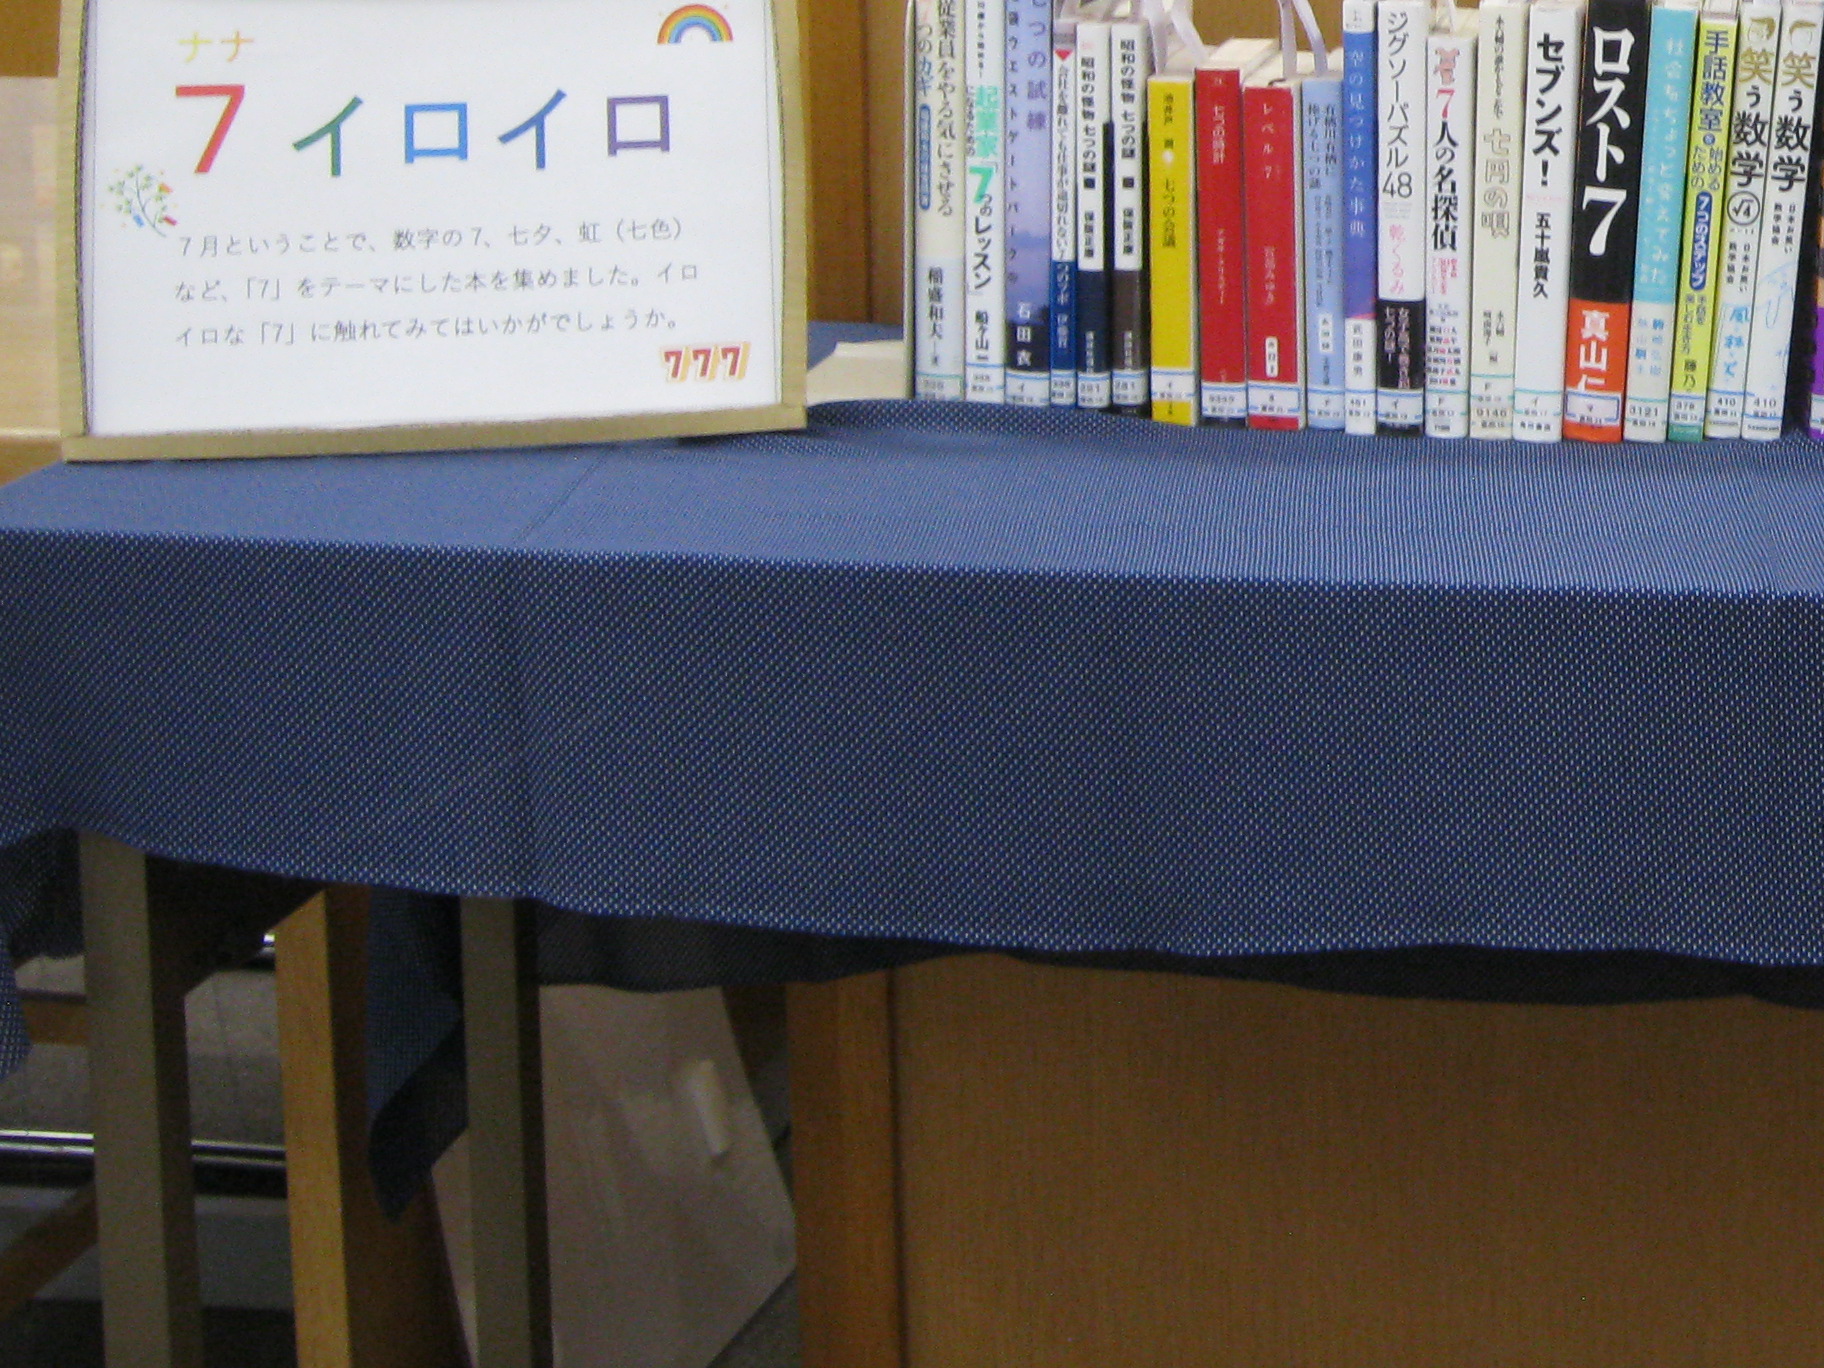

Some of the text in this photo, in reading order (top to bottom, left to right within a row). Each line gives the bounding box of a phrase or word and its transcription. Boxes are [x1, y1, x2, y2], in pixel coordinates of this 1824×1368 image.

[178, 29, 254, 62] ナナ
[1120, 39, 1136, 159] 昭和の怪物 七つの謎
[1081, 57, 1096, 173] 昭和の怪物 七つの謎
[1349, 50, 1366, 238] 空の見つけかた事典
[1382, 11, 1412, 199] ジグソーパズル48
[1533, 33, 1565, 187] セブンズ!
[1582, 27, 1635, 256] ロスト7
[1731, 47, 1775, 188] 笑う数学
[1770, 50, 1817, 192] 笑う数学
[1162, 178, 1176, 248] 七つの会議
[1431, 88, 1461, 252] 7人の名探偵
[1481, 128, 1511, 239] 七円の唄
[1389, 223, 1406, 294] 乾くるみ
[1533, 213, 1551, 299] 五十嵐貴久
[1580, 310, 1610, 391] 真山仁
[1717, 398, 1736, 407] 410
[1753, 398, 1777, 407] 410
